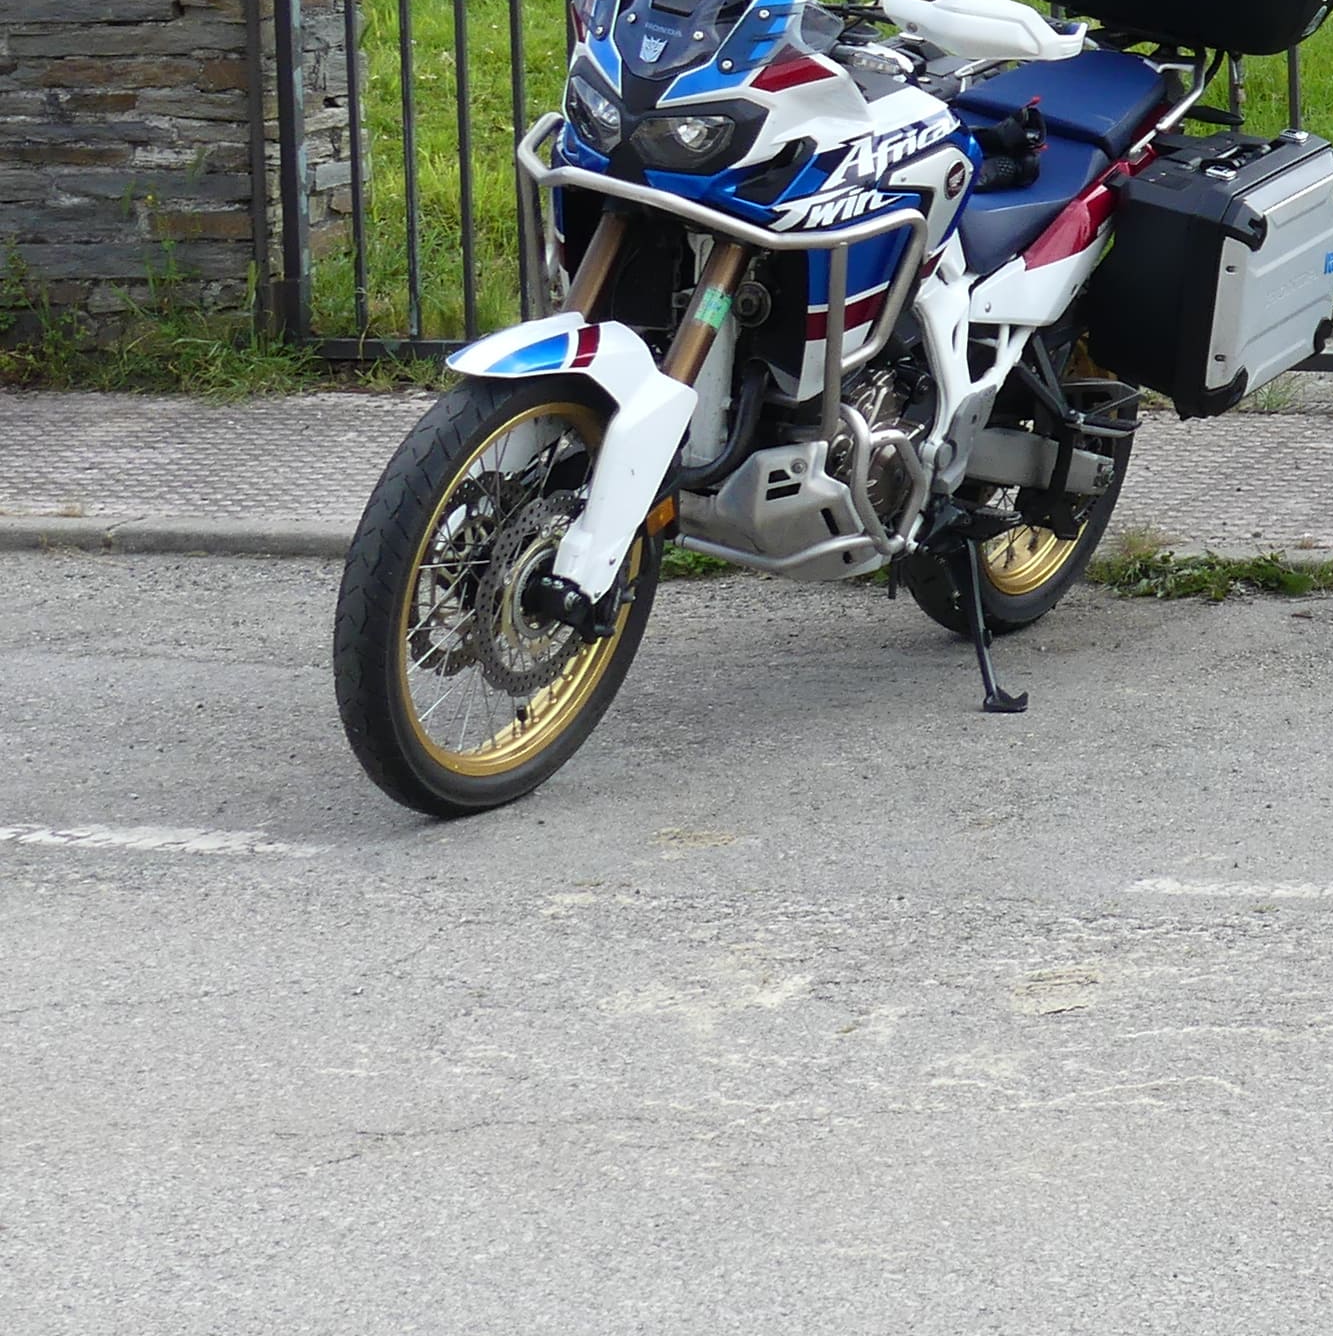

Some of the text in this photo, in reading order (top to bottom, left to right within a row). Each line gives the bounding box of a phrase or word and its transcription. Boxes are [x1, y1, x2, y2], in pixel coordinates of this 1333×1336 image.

[645, 21, 682, 37] HONDA
[819, 118, 961, 191] Africa
[768, 184, 902, 232] Twin
